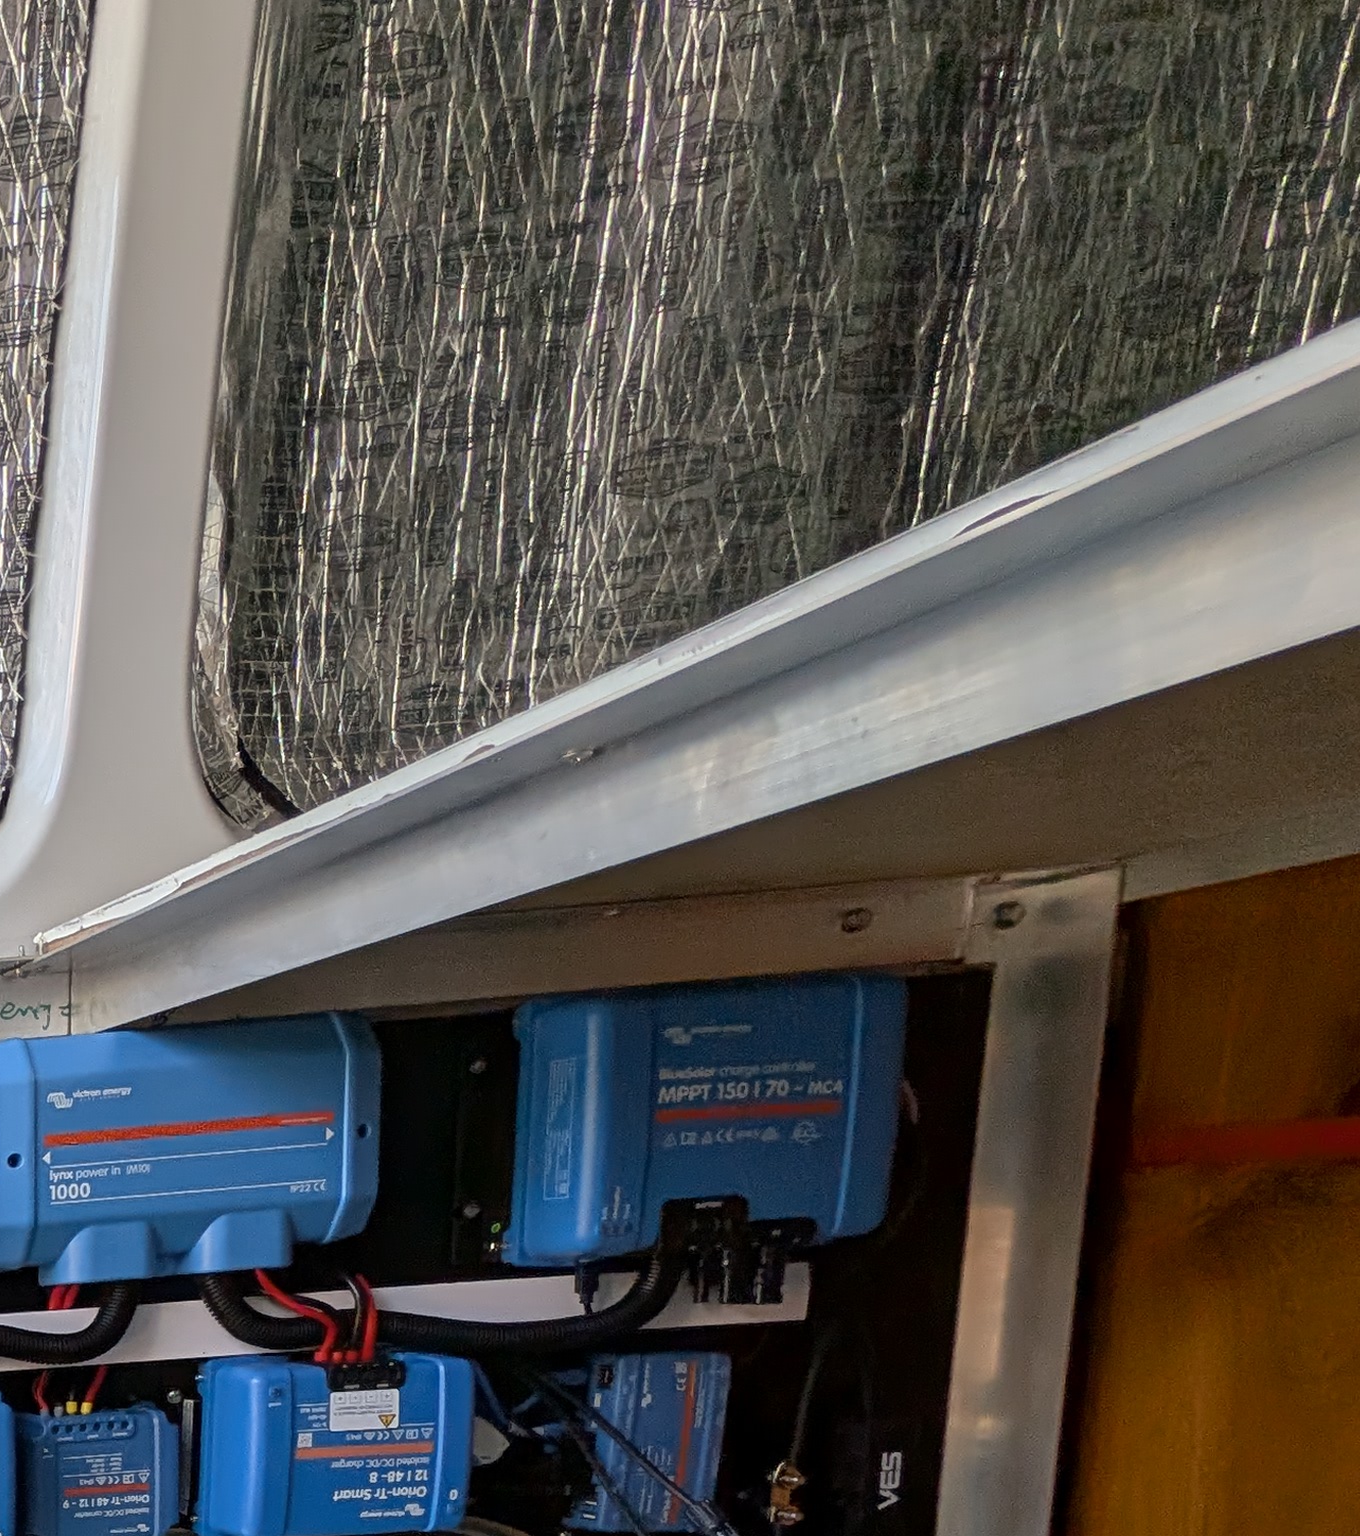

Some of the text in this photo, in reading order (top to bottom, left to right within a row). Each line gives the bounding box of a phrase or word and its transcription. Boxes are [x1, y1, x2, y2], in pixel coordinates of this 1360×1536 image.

[73, 1085, 132, 1099] victron energy
[658, 1084, 712, 1104] MPPT
[717, 1081, 749, 1100] 150
[49, 1169, 73, 1184] lynx
[75, 1166, 109, 1181] power
[111, 1164, 121, 1176] in
[49, 1182, 91, 1200] 1000
[415, 1469, 429, 1482] 12
[111, 1494, 150, 1505] Orion-Tr
[333, 1485, 427, 1502] Orion-Tr Smart
